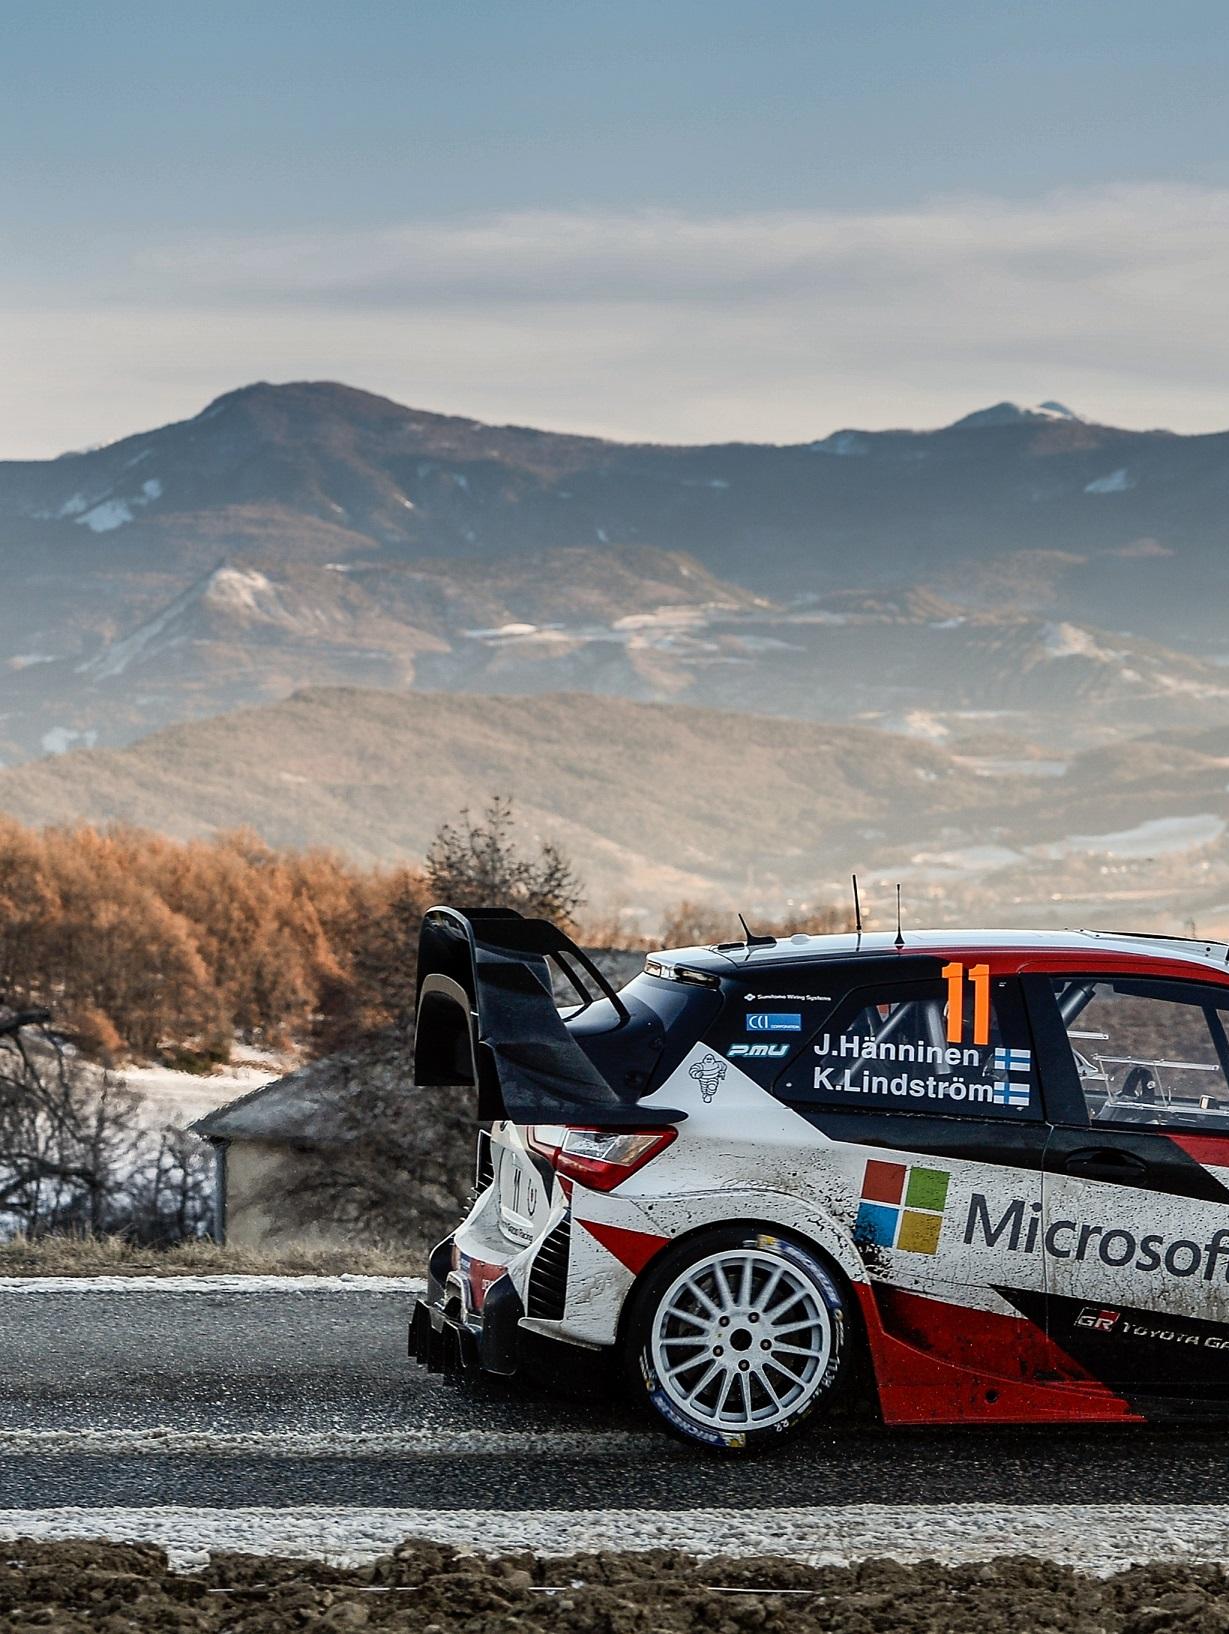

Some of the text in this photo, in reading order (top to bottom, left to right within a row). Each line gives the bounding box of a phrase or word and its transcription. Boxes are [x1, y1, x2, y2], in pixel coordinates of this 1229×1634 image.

[941, 962, 990, 1046] 11
[813, 1033, 980, 1067] J.Hänninen
[813, 1066, 993, 1103] K.Lindström
[1077, 1315, 1114, 1331] GR
[1122, 1321, 1200, 1345] TOYOTA
